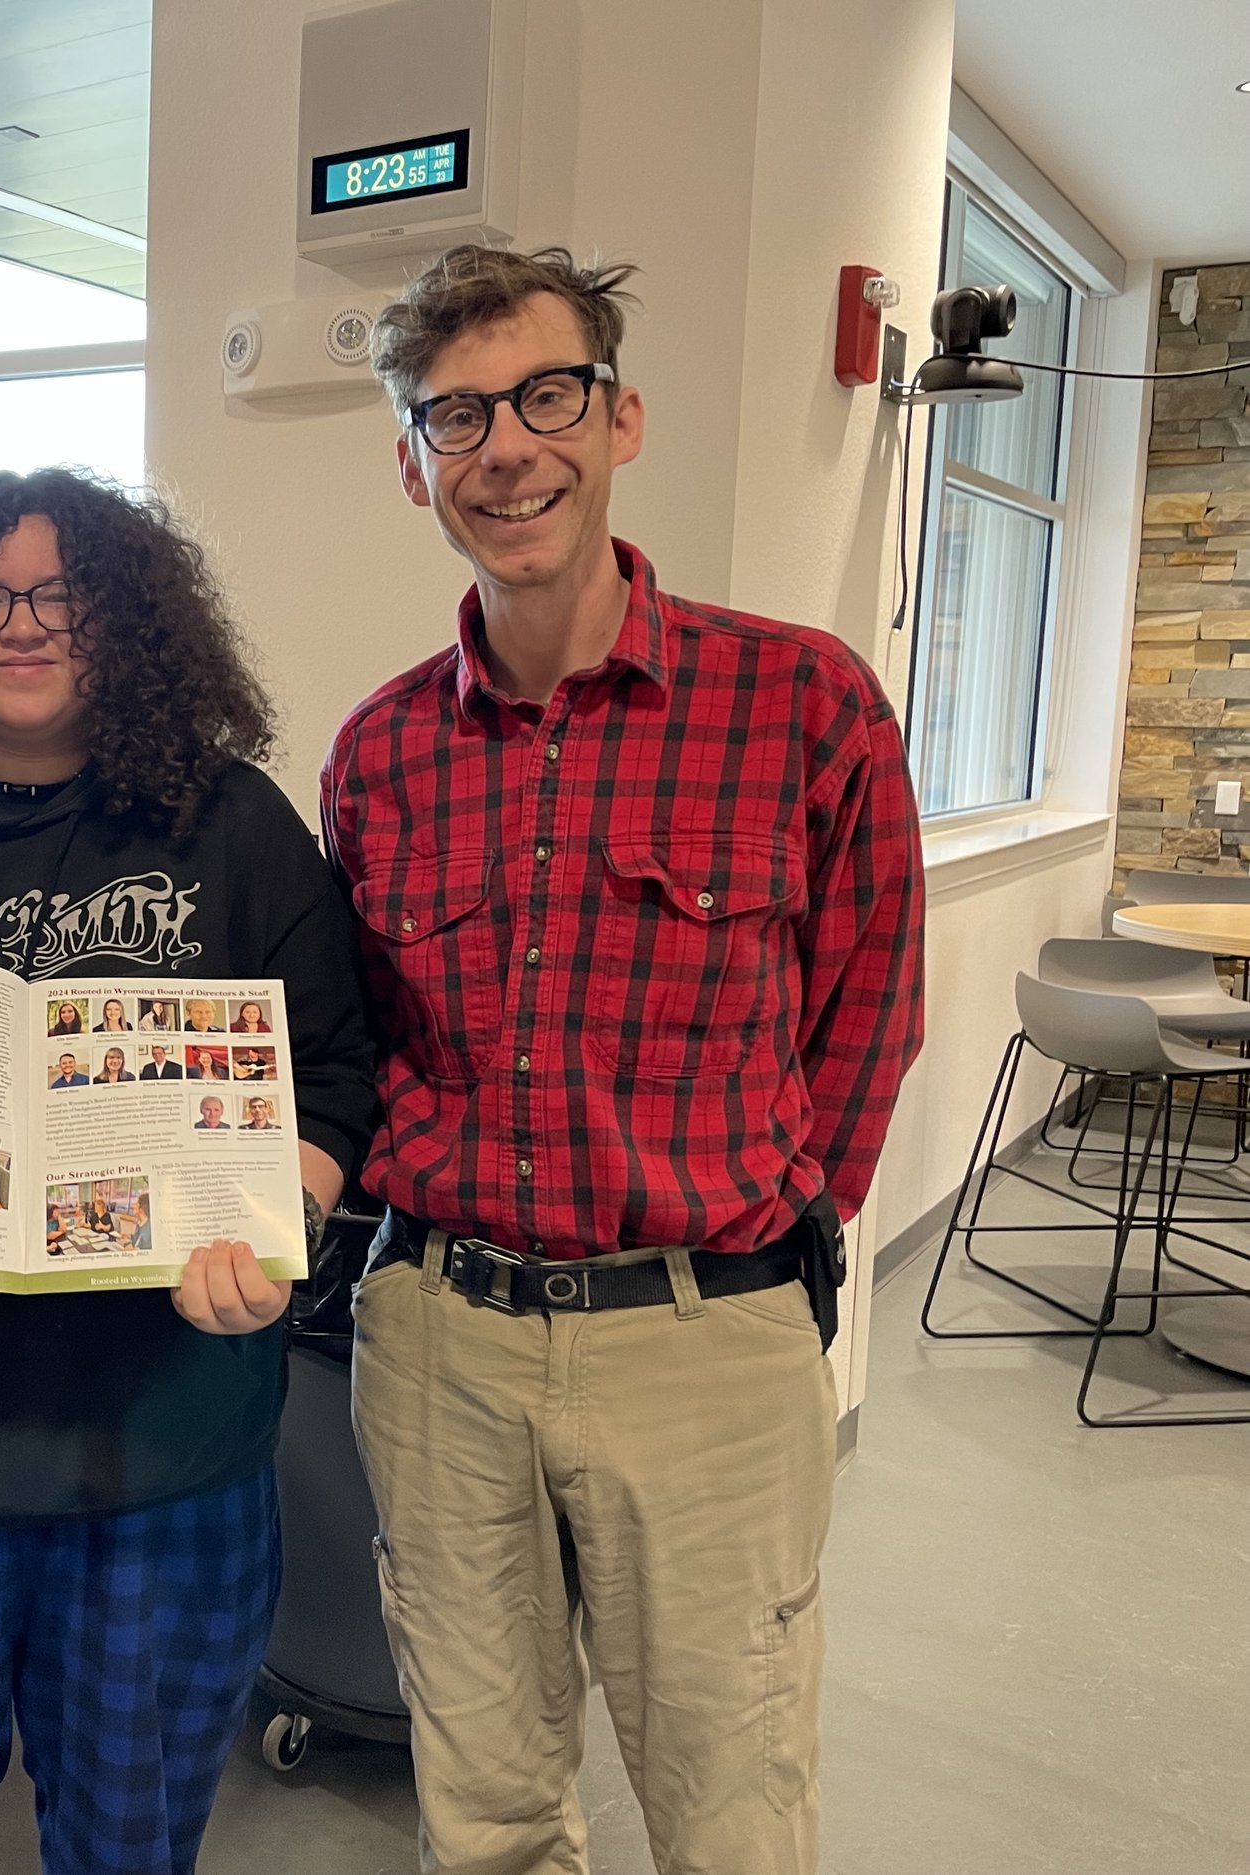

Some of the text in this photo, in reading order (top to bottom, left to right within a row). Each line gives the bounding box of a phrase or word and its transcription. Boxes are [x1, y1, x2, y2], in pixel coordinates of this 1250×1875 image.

[434, 144, 450, 157] TUE
[433, 158, 450, 170] APR
[346, 149, 425, 196] 8:23 AM
[408, 165, 426, 184] 55
[436, 171, 446, 182] 23
[48, 989, 68, 997] 2024
[114, 987, 155, 996] Wyoming
[185, 988, 194, 996] of
[46, 1173, 65, 1182] Our
[68, 1168, 114, 1179] Strategic
[118, 1166, 142, 1174] Plan
[90, 1276, 119, 1285] Rooted
[120, 1275, 129, 1283] in
[130, 1273, 168, 1284] Wyoming
